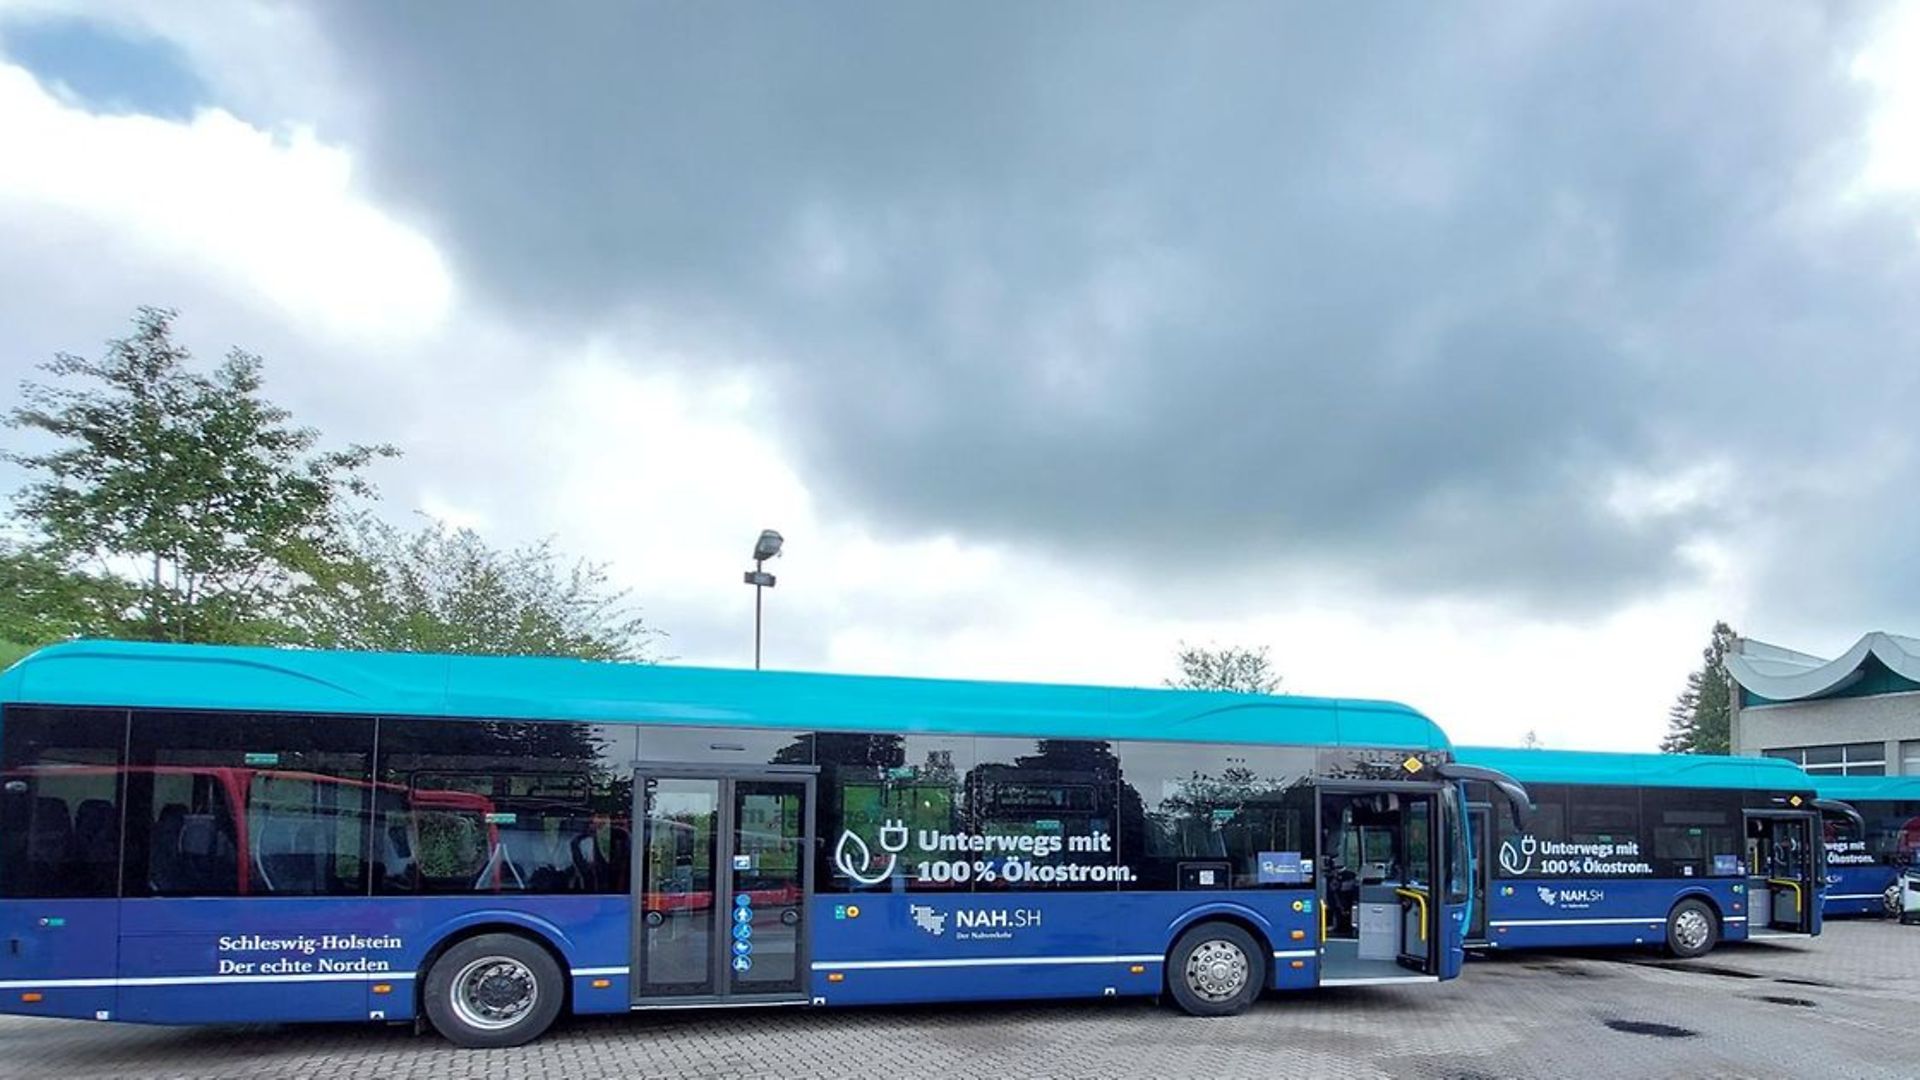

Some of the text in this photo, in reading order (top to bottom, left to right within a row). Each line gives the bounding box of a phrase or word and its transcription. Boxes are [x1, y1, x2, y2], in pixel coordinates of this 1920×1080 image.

[918, 830, 1112, 856] Unterwegs mit
[1540, 841, 1639, 858] Unterwegs mit
[1002, 854, 1137, 882] Ökostrom.
[1584, 857, 1653, 873] Ökostrom.
[1560, 889, 1604, 901] NAH.SH
[956, 909, 1042, 928] NAH.SH
[218, 934, 402, 954] Schleswig-Holstein
[218, 957, 389, 974] Der echte Norden
